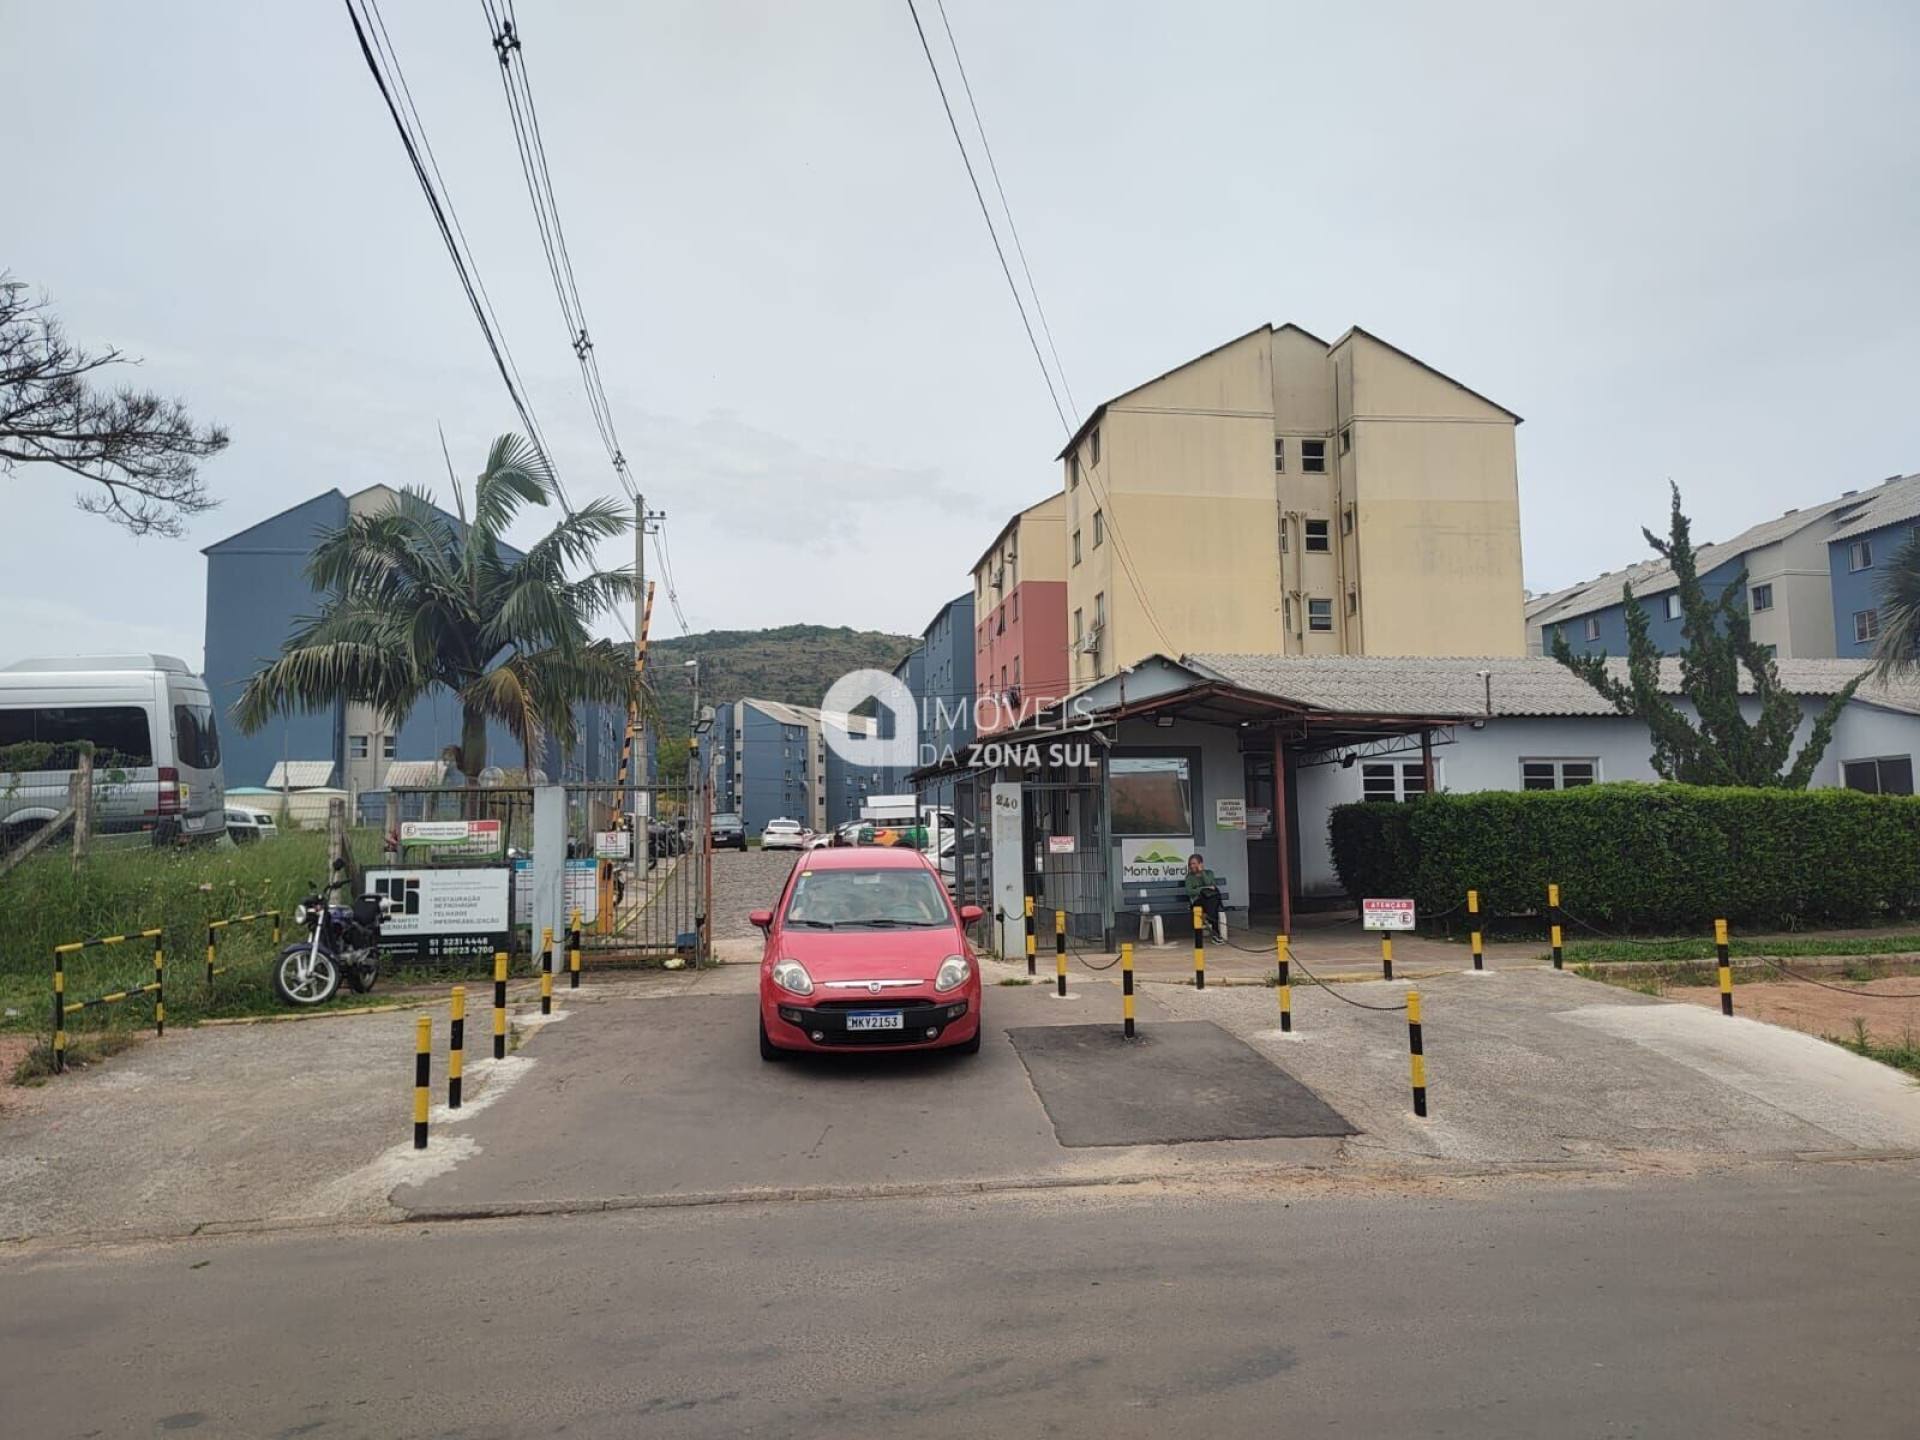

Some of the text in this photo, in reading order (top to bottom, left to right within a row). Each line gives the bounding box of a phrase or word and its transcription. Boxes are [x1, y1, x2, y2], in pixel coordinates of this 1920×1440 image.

[1124, 865, 1189, 876] Monte Verd
[1371, 901, 1407, 909] ATENÇÃO
